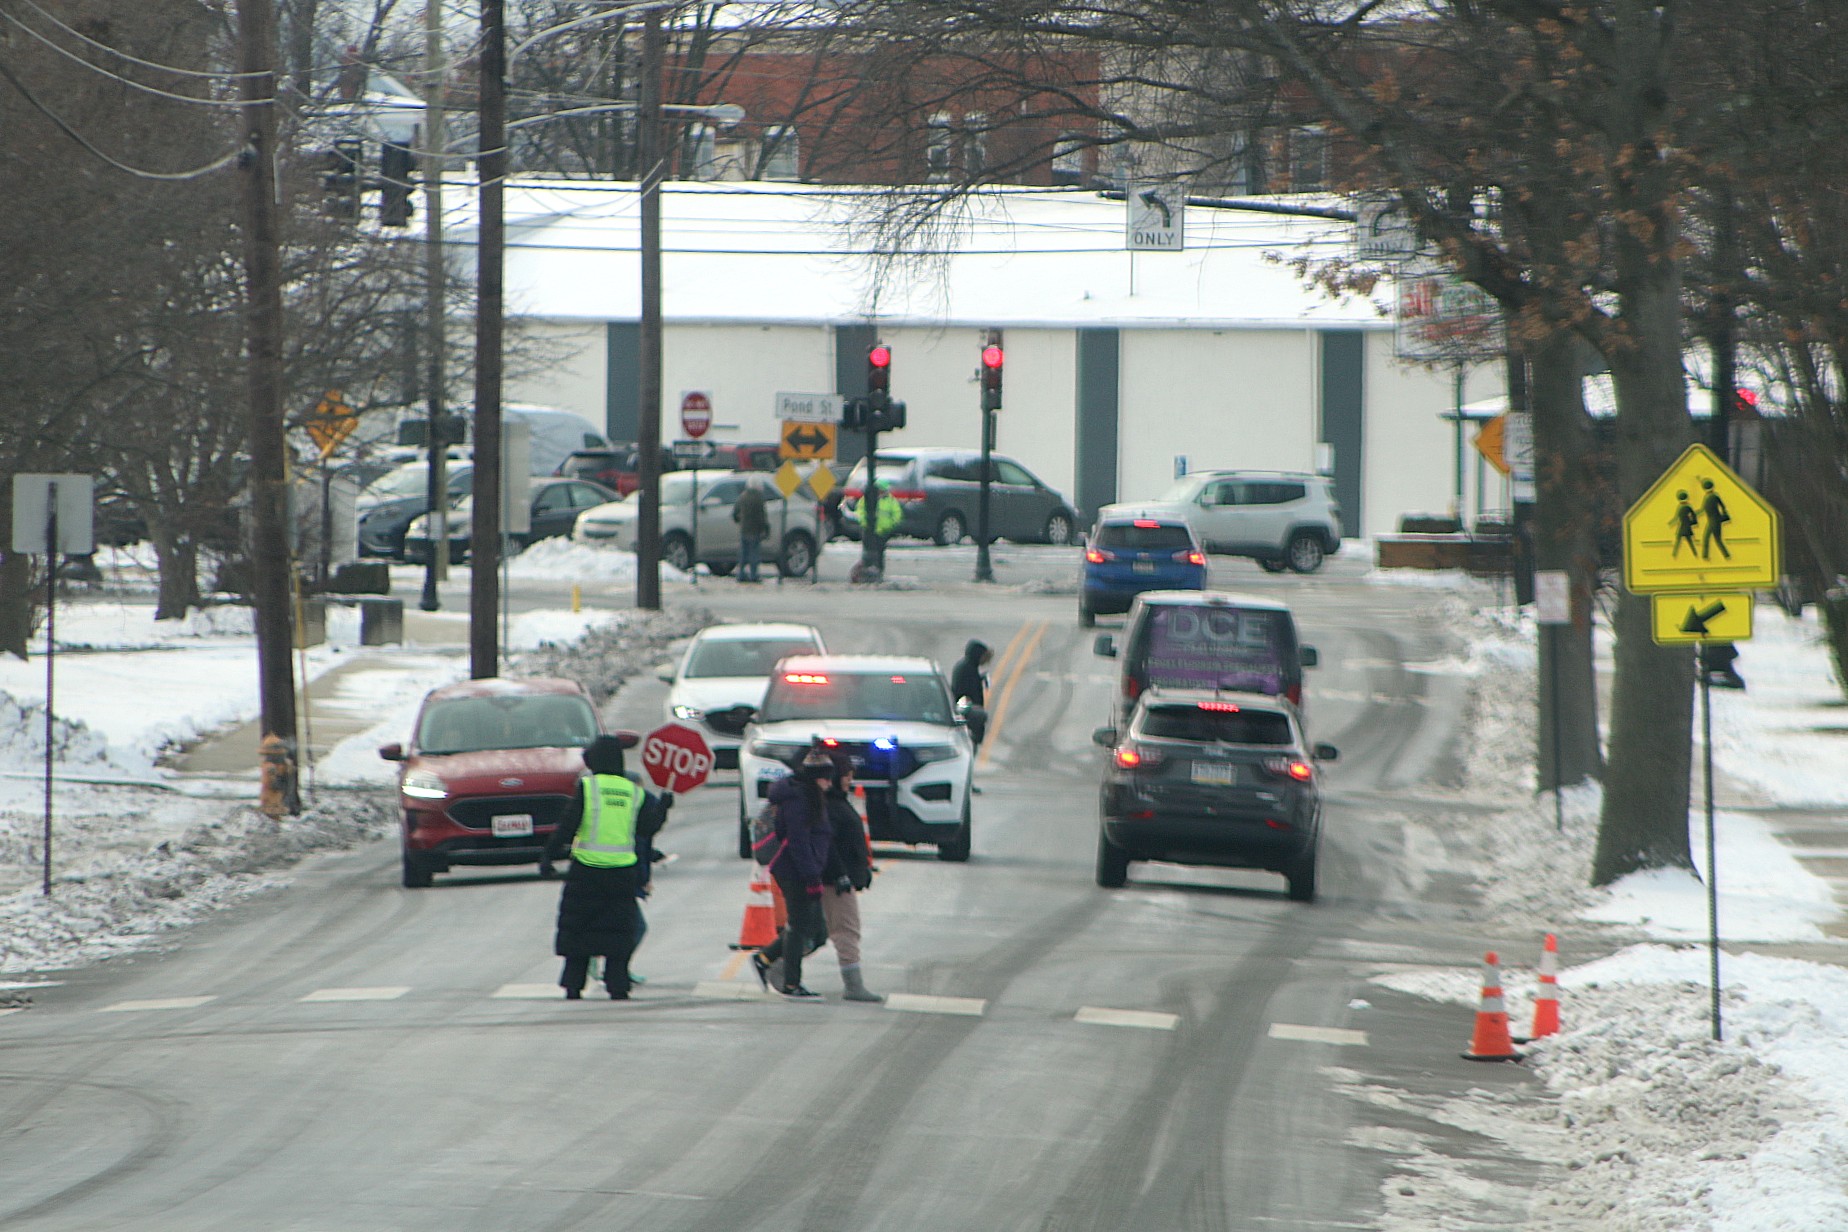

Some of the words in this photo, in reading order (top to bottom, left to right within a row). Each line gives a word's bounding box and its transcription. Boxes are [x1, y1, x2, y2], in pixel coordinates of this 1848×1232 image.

[1134, 232, 1175, 246] ONLY
[783, 397, 813, 415] Pond
[1166, 609, 1268, 645] DCE
[645, 737, 709, 778] STOP
